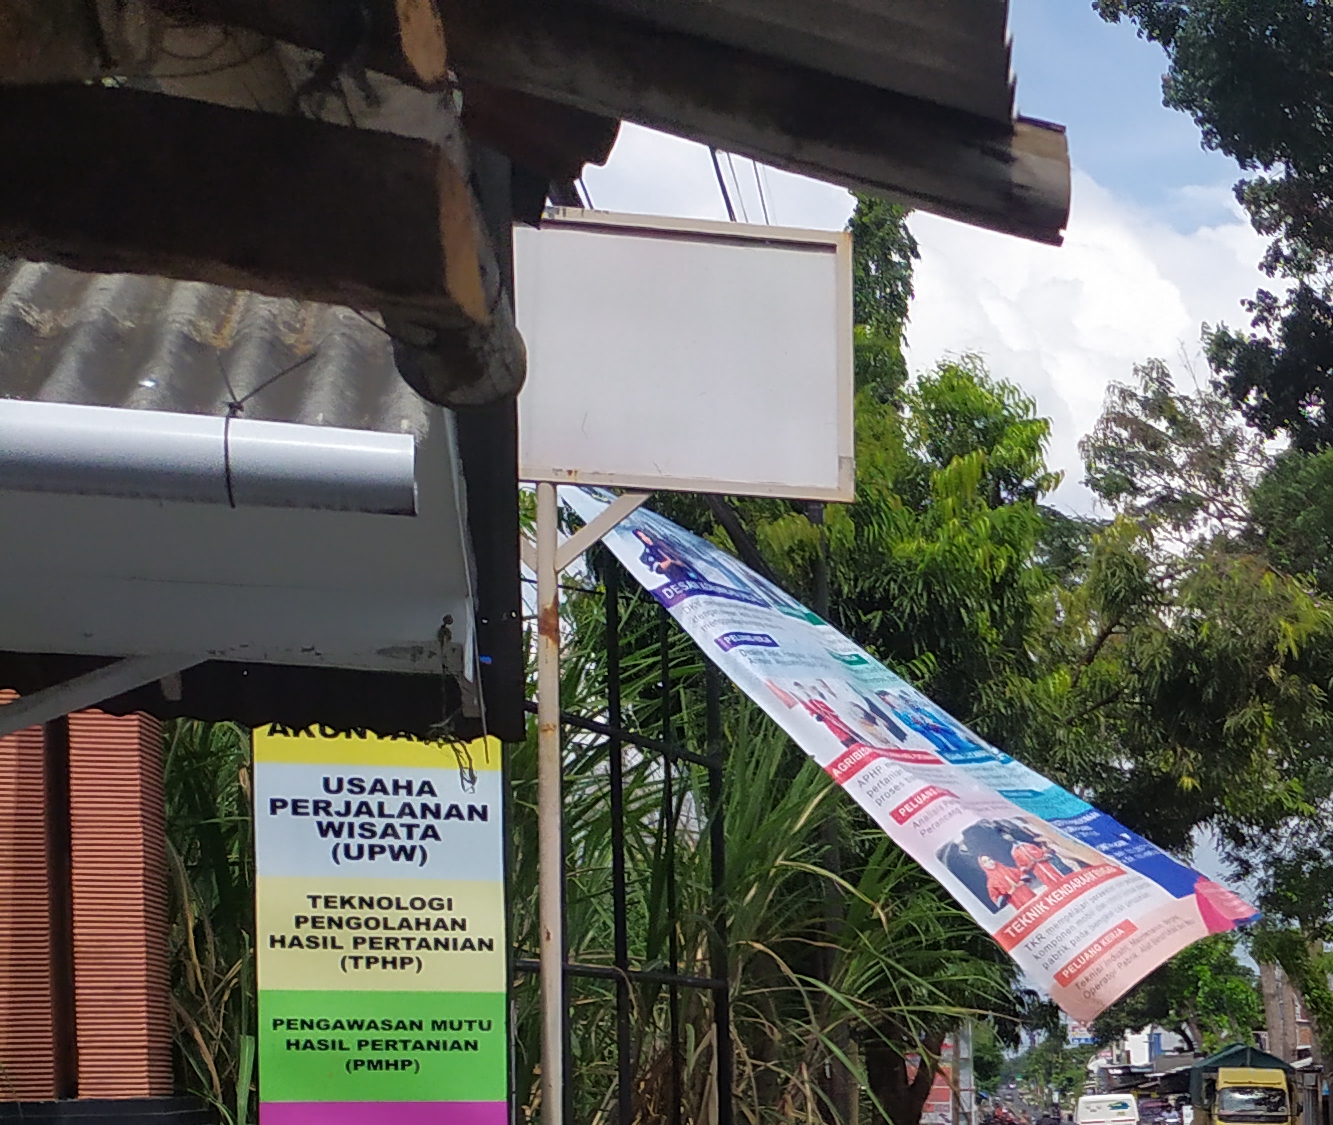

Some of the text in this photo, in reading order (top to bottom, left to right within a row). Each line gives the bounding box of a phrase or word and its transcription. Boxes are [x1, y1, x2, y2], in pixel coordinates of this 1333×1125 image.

[322, 776, 438, 797] USAHA
[857, 765, 883, 789] APHP
[269, 797, 489, 822] PERJALANAN
[316, 820, 442, 841] WISATA
[331, 843, 429, 867] (UPW)
[306, 894, 453, 911] TEKNOLOGI
[294, 914, 467, 931] PENGOLAHAN
[1004, 901, 1050, 938] TEKNIK
[269, 934, 494, 951] HASIL PERTANIAN
[1024, 933, 1046, 952] TKR
[1031, 922, 1077, 962] komponen
[1100, 926, 1125, 947] KERJA
[340, 955, 423, 974] (TPHP)
[1082, 970, 1118, 1000] Operator
[272, 1018, 493, 1032] PENGAWASAN MUTU
[286, 1038, 479, 1052] HASIL PERTANIAN
[345, 1058, 421, 1074] (PMHP)
